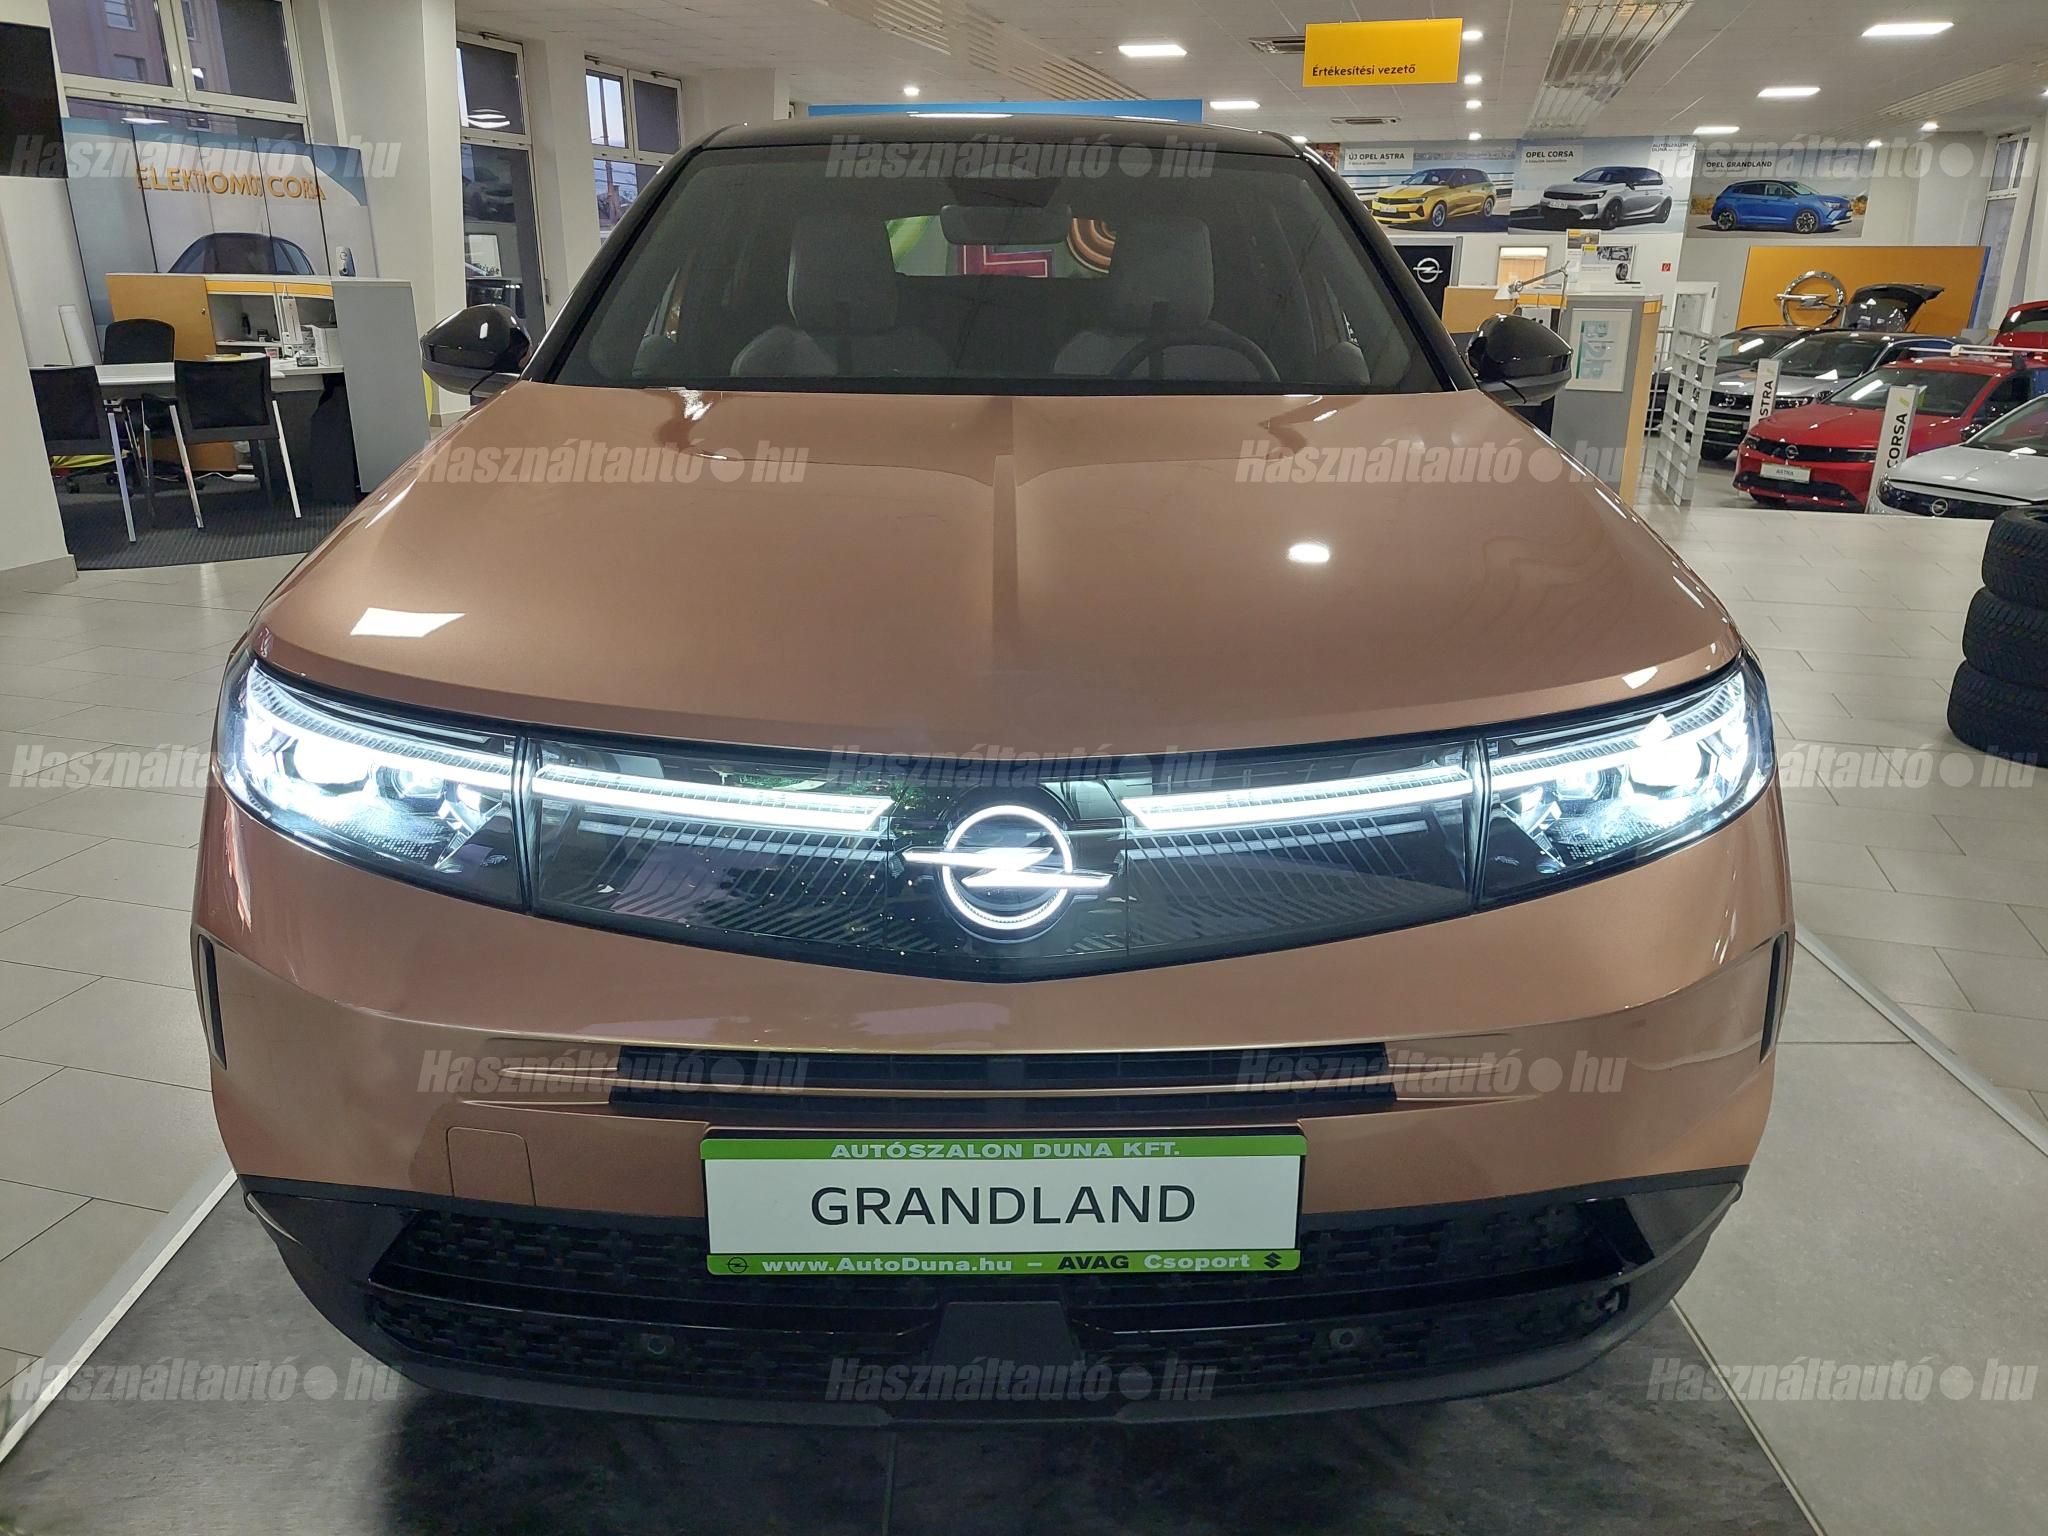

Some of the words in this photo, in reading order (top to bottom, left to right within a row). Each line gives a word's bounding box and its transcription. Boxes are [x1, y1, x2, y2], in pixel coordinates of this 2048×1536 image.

[1312, 64, 1375, 77] Értékesítési
[1378, 64, 1416, 75] vezető
[1380, 152, 1405, 160] ASTRA
[1547, 150, 1574, 158] CORSA
[1726, 160, 1773, 168] GRANDLAND
[1758, 380, 1774, 421] STRA
[1887, 412, 1908, 469] CORSA
[831, 1141, 1022, 1159] AUTÓSZALON
[1033, 1142, 1113, 1158] DUNA
[1123, 1141, 1180, 1156] KFT.
[811, 1185, 1196, 1225] GRANDLAND
[761, 1256, 1012, 1272] www.AutoDuna.hu
[1057, 1255, 1129, 1270] AVAG
[1143, 1253, 1251, 1272] Csoport
